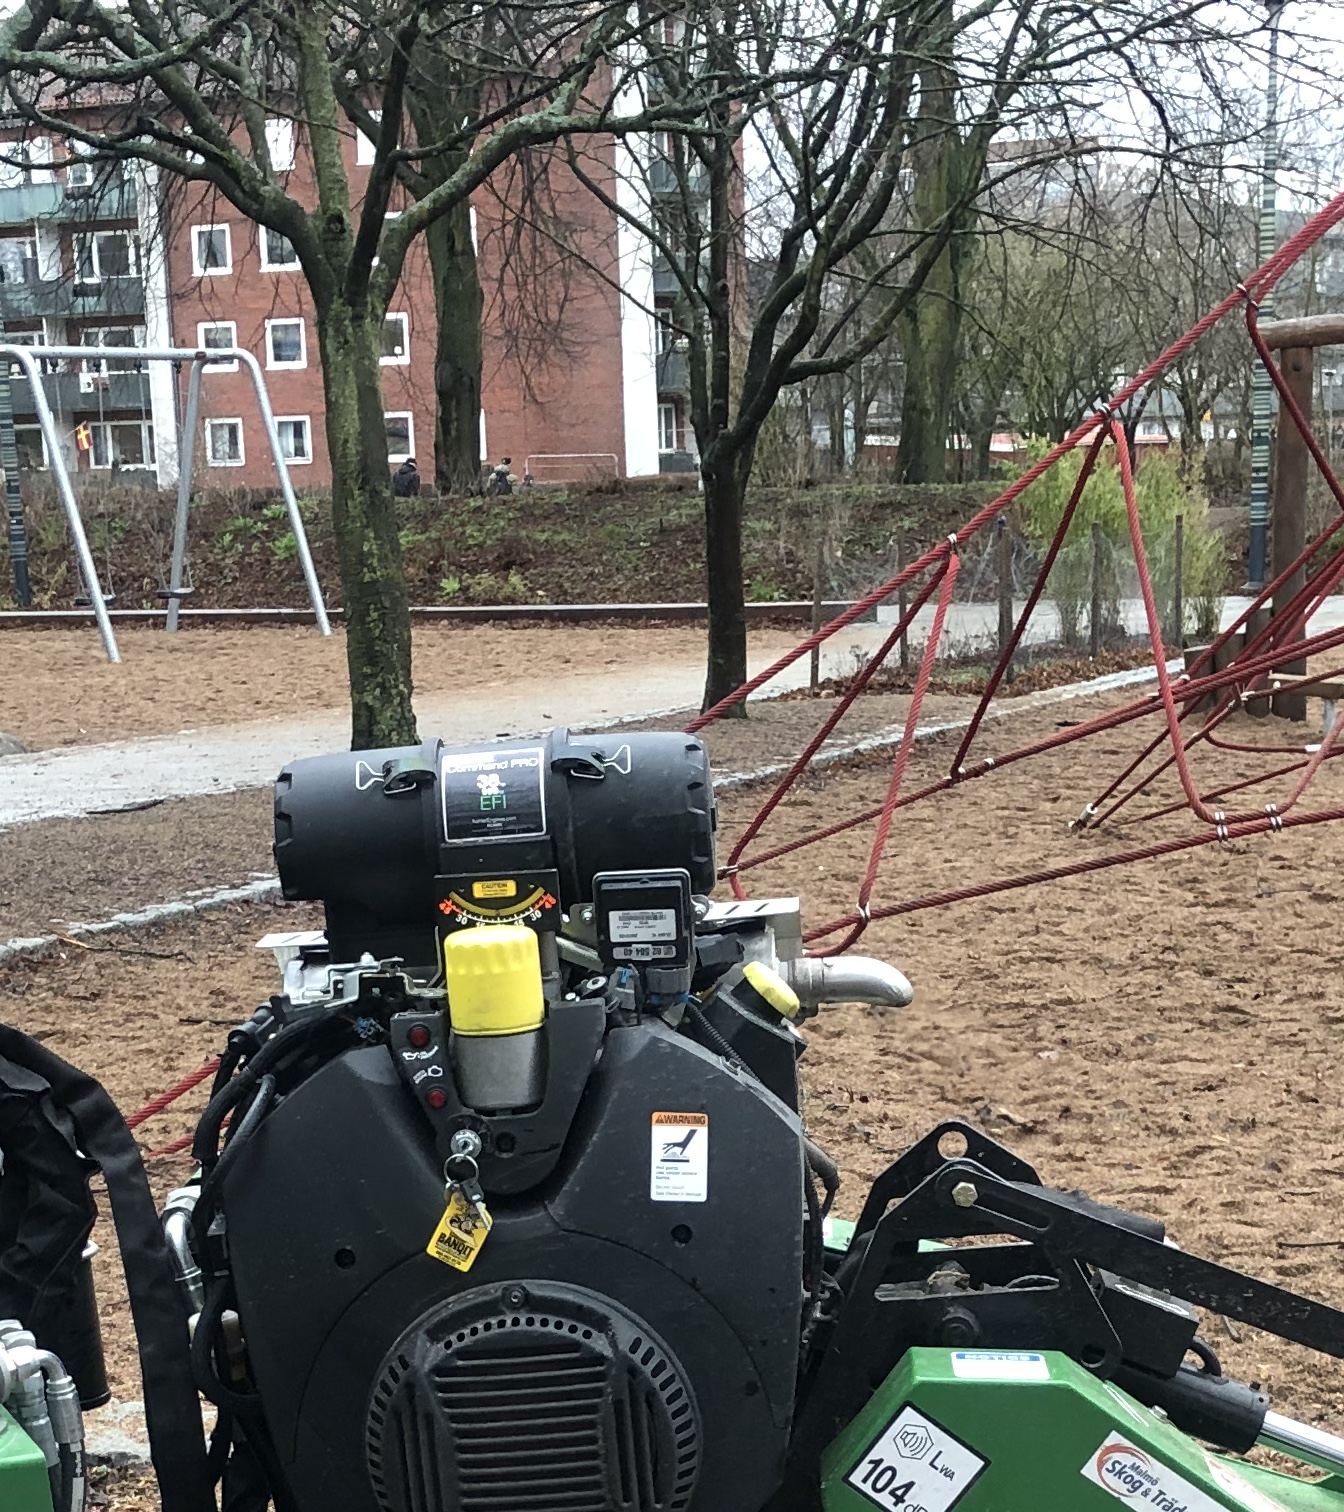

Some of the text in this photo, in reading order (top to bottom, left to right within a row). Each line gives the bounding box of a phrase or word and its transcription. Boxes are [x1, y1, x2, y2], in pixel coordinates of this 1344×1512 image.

[511, 758, 538, 768] PRO
[481, 795, 506, 810] EFI
[455, 914, 468, 925] 30
[530, 910, 542, 921] 30
[664, 1114, 706, 1124] WARNING
[436, 1232, 476, 1256] BANDIT
[1105, 1459, 1144, 1493] Skog
[1141, 1488, 1152, 1498] &
[1128, 1461, 1159, 1486] Malmö
[861, 1457, 916, 1507] 104
